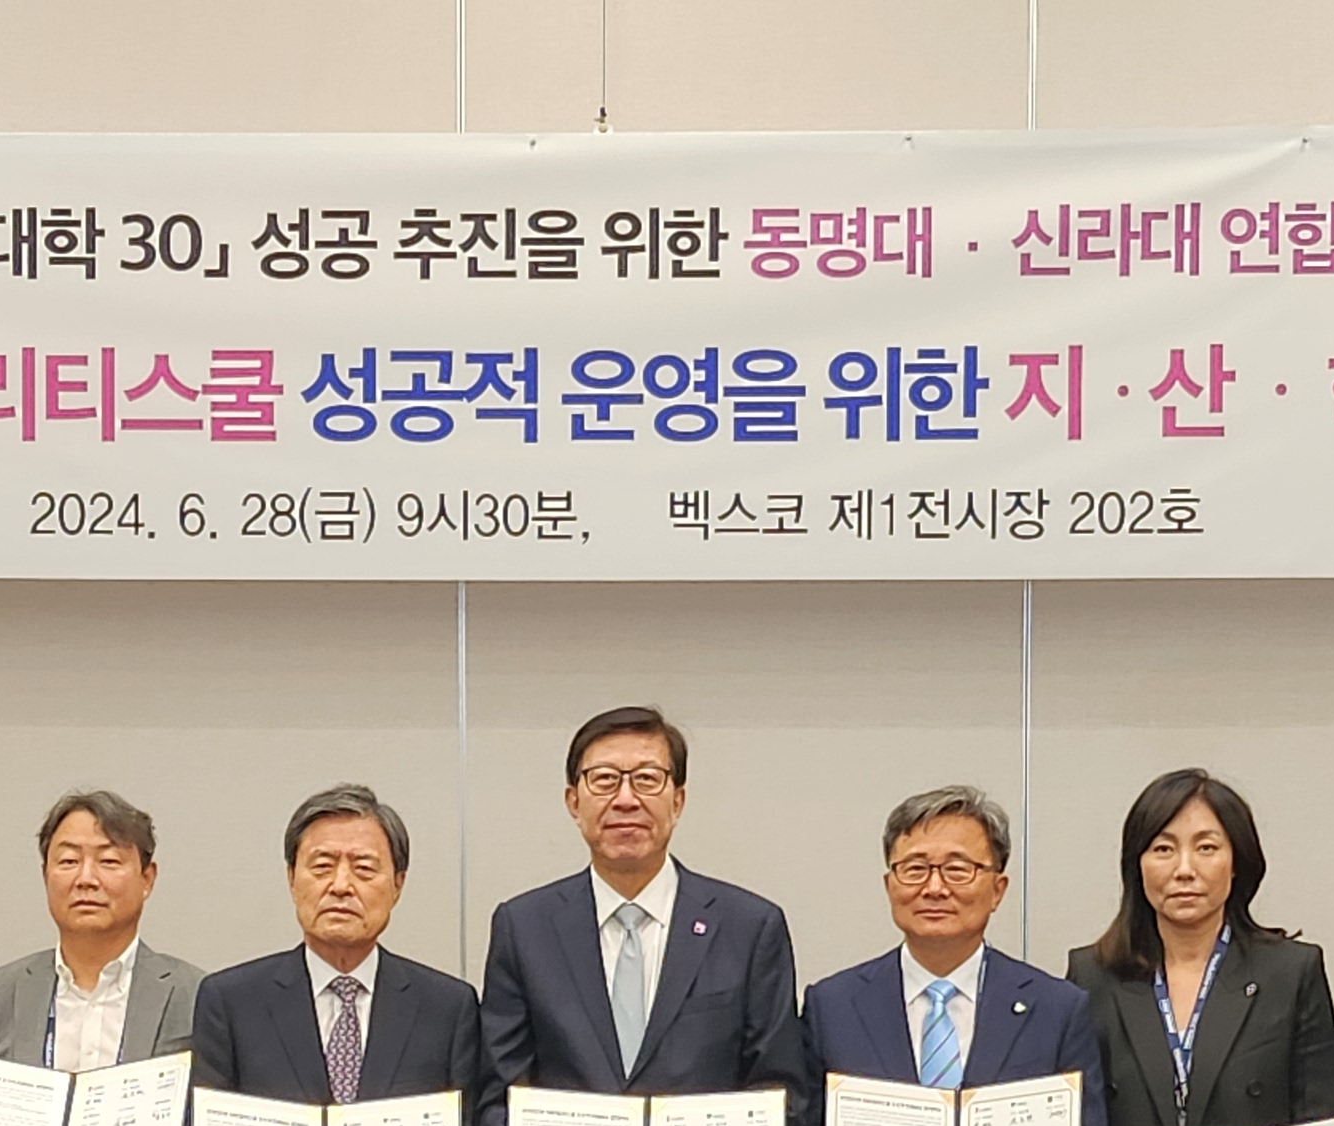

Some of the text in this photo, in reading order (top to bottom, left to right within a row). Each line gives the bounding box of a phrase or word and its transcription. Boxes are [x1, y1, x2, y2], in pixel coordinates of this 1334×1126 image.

[251, 207, 379, 281] 성공
[393, 207, 586, 281] 추진을
[601, 206, 731, 281] 위한
[744, 206, 934, 280] 동명대
[1011, 203, 1203, 278] 신라대
[301, 347, 541, 445] 성공적
[561, 347, 809, 444] 운영을
[823, 346, 991, 443] 위한
[30, 487, 1207, 546] 2024. 6. 28(금) 9시30분, 벡스코 제1전시장 202호
